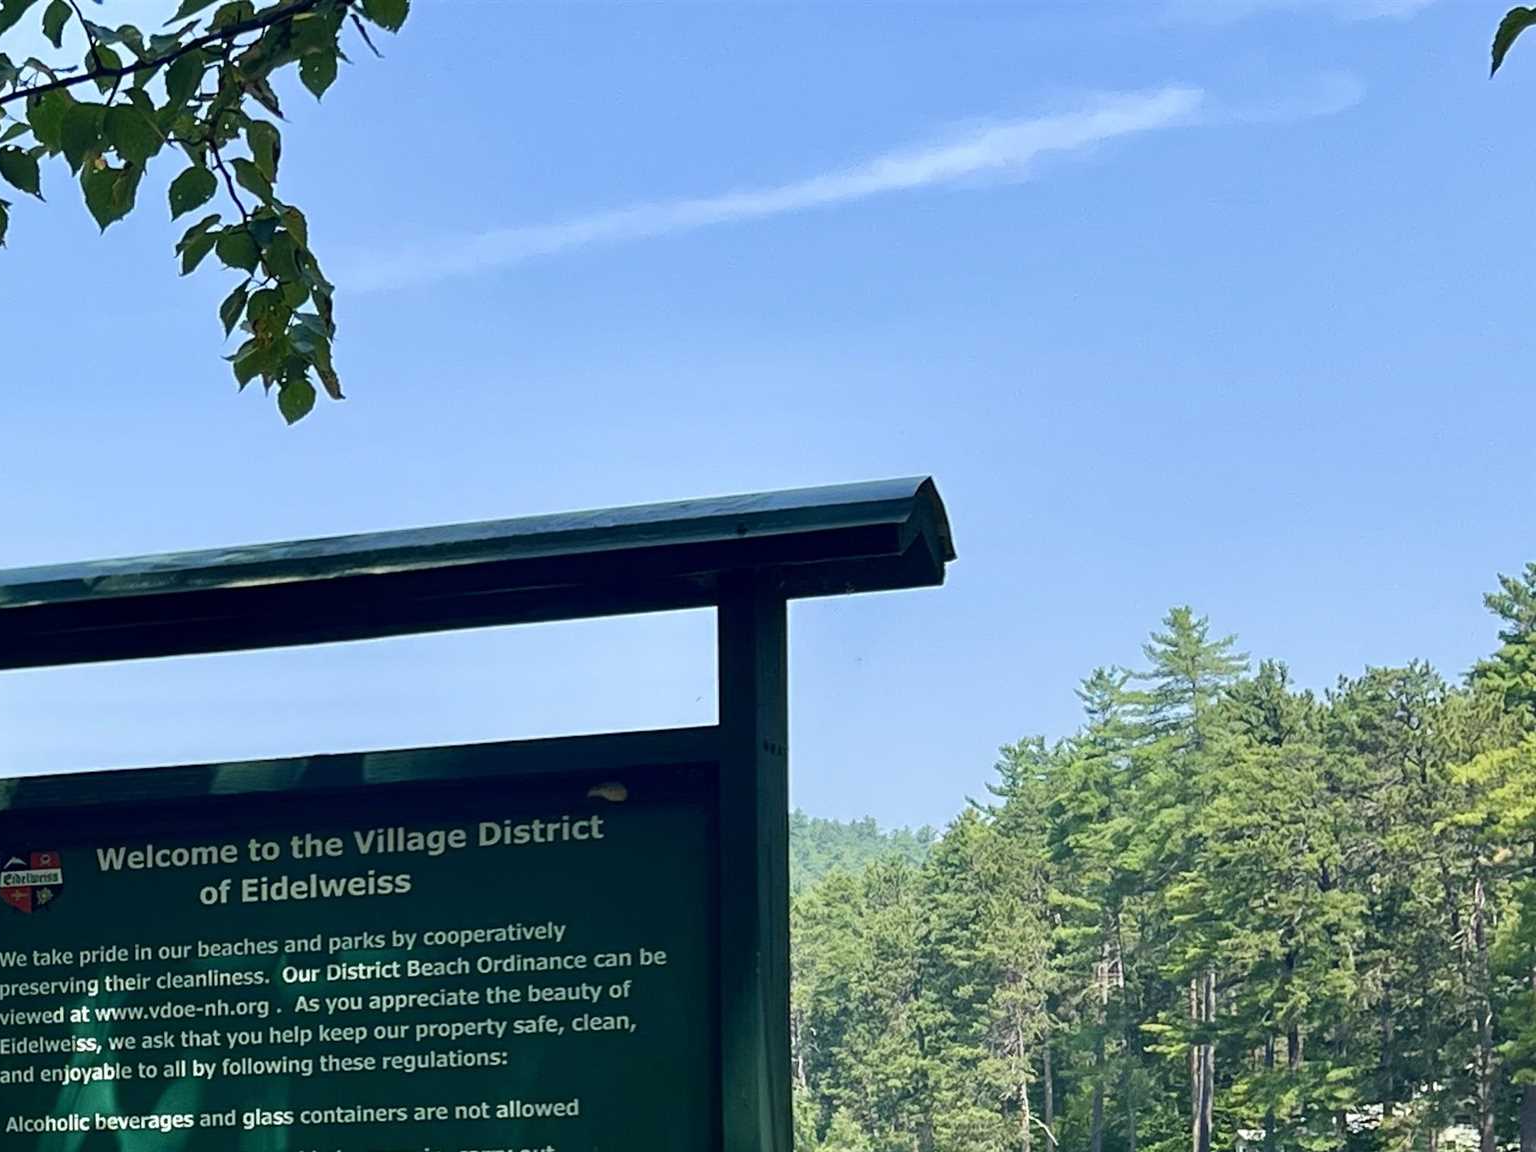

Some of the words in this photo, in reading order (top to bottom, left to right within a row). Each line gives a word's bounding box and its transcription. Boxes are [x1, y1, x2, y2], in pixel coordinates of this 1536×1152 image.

[96, 844, 238, 871] Welcome
[247, 838, 281, 861] to
[290, 833, 344, 858] the
[353, 826, 467, 855] Village
[479, 815, 605, 846] District
[199, 878, 232, 904] of
[241, 869, 412, 902] Eidelweiss
[32, 948, 74, 966] take
[79, 945, 129, 967] pride
[134, 944, 152, 960] in
[158, 945, 193, 959] our
[197, 938, 279, 957] beaches
[284, 933, 322, 952] and
[328, 931, 386, 954] parks
[391, 930, 417, 950] by
[423, 921, 567, 947] cooperatively
[0, 976, 99, 1000] preserving
[104, 973, 152, 991] their
[156, 969, 270, 989] cleanliness.
[282, 966, 321, 983] Our
[326, 960, 401, 980] District
[407, 957, 470, 976] Beach
[476, 954, 587, 973] Ordinance
[593, 952, 632, 967] can
[639, 947, 667, 965] be
[0, 1035, 103, 1054] Eidelweiss,
[108, 1036, 136, 1050] we
[141, 1031, 175, 1048] ask
[180, 1029, 222, 1047] that
[226, 1031, 263, 1049] you
[269, 1025, 313, 1046] help
[318, 1024, 368, 1043] keep
[373, 1025, 410, 1039] our
[415, 1018, 508, 1041] property
[512, 1014, 565, 1035] safe,
[571, 1013, 637, 1032] clean,
[0, 1065, 34, 1083] and
[40, 1062, 133, 1085] enjoyable
[137, 1062, 158, 1078] to
[163, 1059, 186, 1077] all
[192, 1059, 217, 1079] by
[222, 1055, 313, 1076] following
[319, 1054, 376, 1071] these
[382, 1049, 508, 1072] regulations:
[5, 1113, 91, 1132] Alcoholic
[94, 1112, 195, 1132] beverages
[199, 1109, 236, 1126] and
[242, 1108, 294, 1129] glass
[300, 1105, 409, 1124] containers
[413, 1106, 449, 1120] are
[455, 1101, 491, 1119] not
[495, 1098, 579, 1118] allowed
